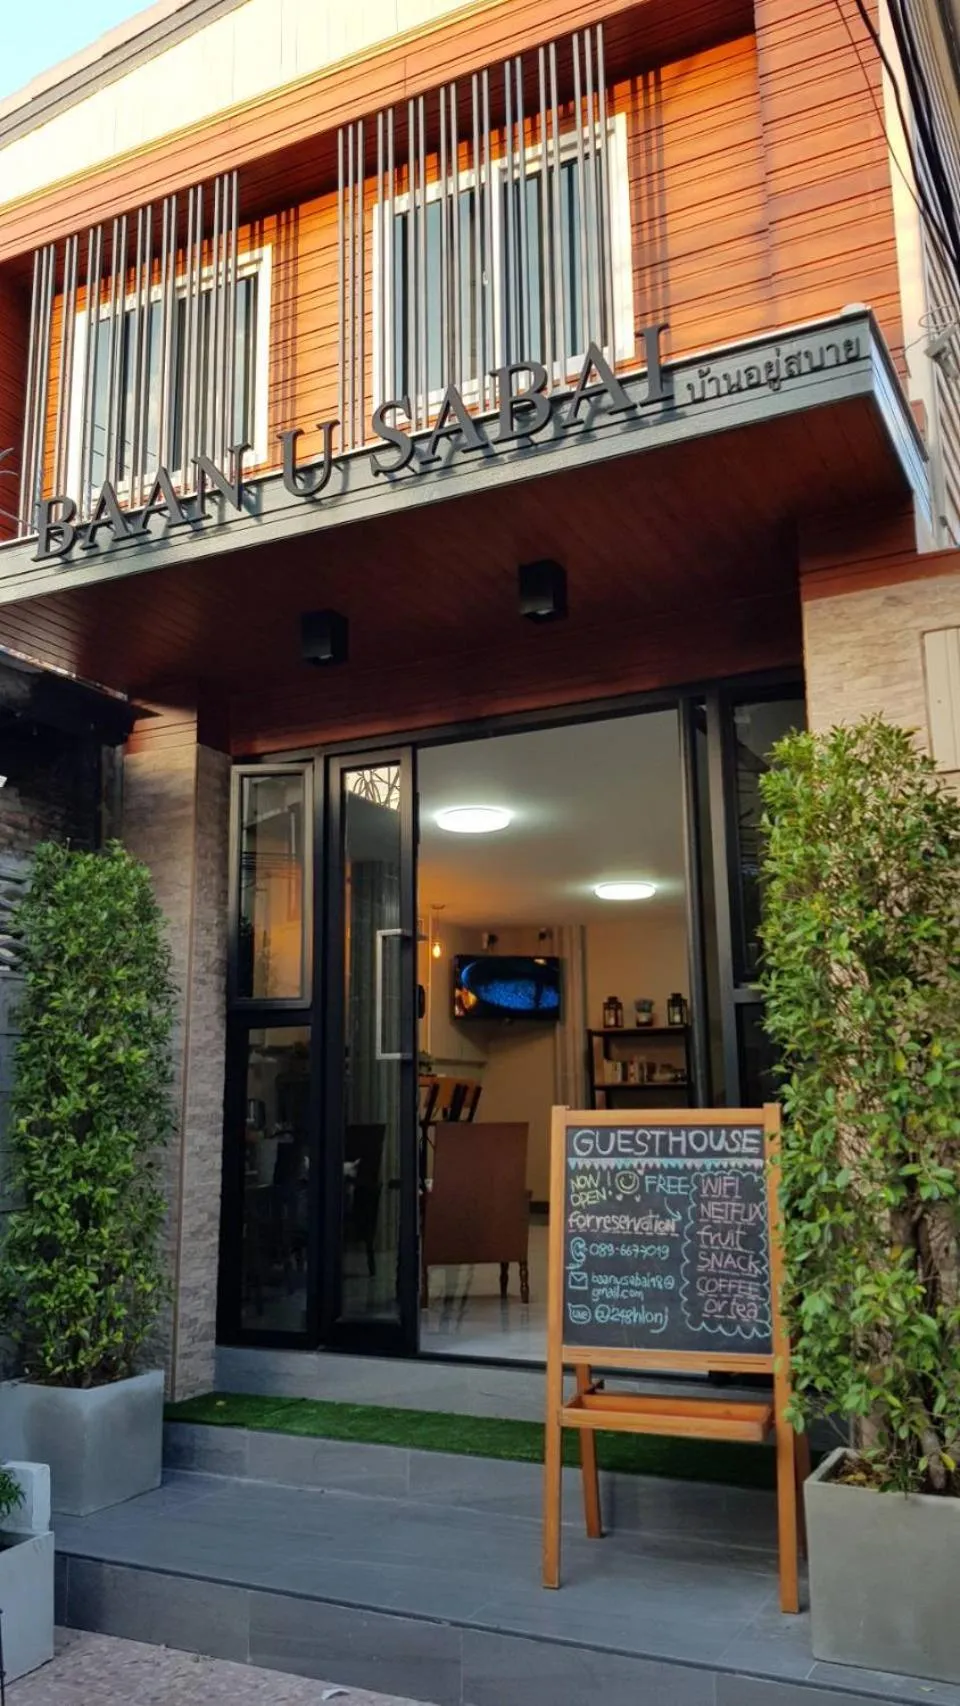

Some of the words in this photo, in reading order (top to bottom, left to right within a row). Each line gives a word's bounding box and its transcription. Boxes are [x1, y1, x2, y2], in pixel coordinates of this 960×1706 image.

[686, 337, 861, 402] บ้านอยู่สบาย
[31, 442, 251, 562] BAAN
[277, 419, 340, 498] U
[369, 323, 676, 477] SABAI
[573, 1129, 760, 1156] GUESTHOUSE
[644, 1174, 690, 1195] FREE
[702, 1176, 741, 1198] WIFI
[700, 1201, 764, 1222] NETFLIX
[696, 1225, 747, 1251] fruit
[697, 1251, 762, 1275] SNACK
[696, 1276, 761, 1297] COFFEE
[704, 1298, 728, 1314] or
[729, 1296, 759, 1320] tea
